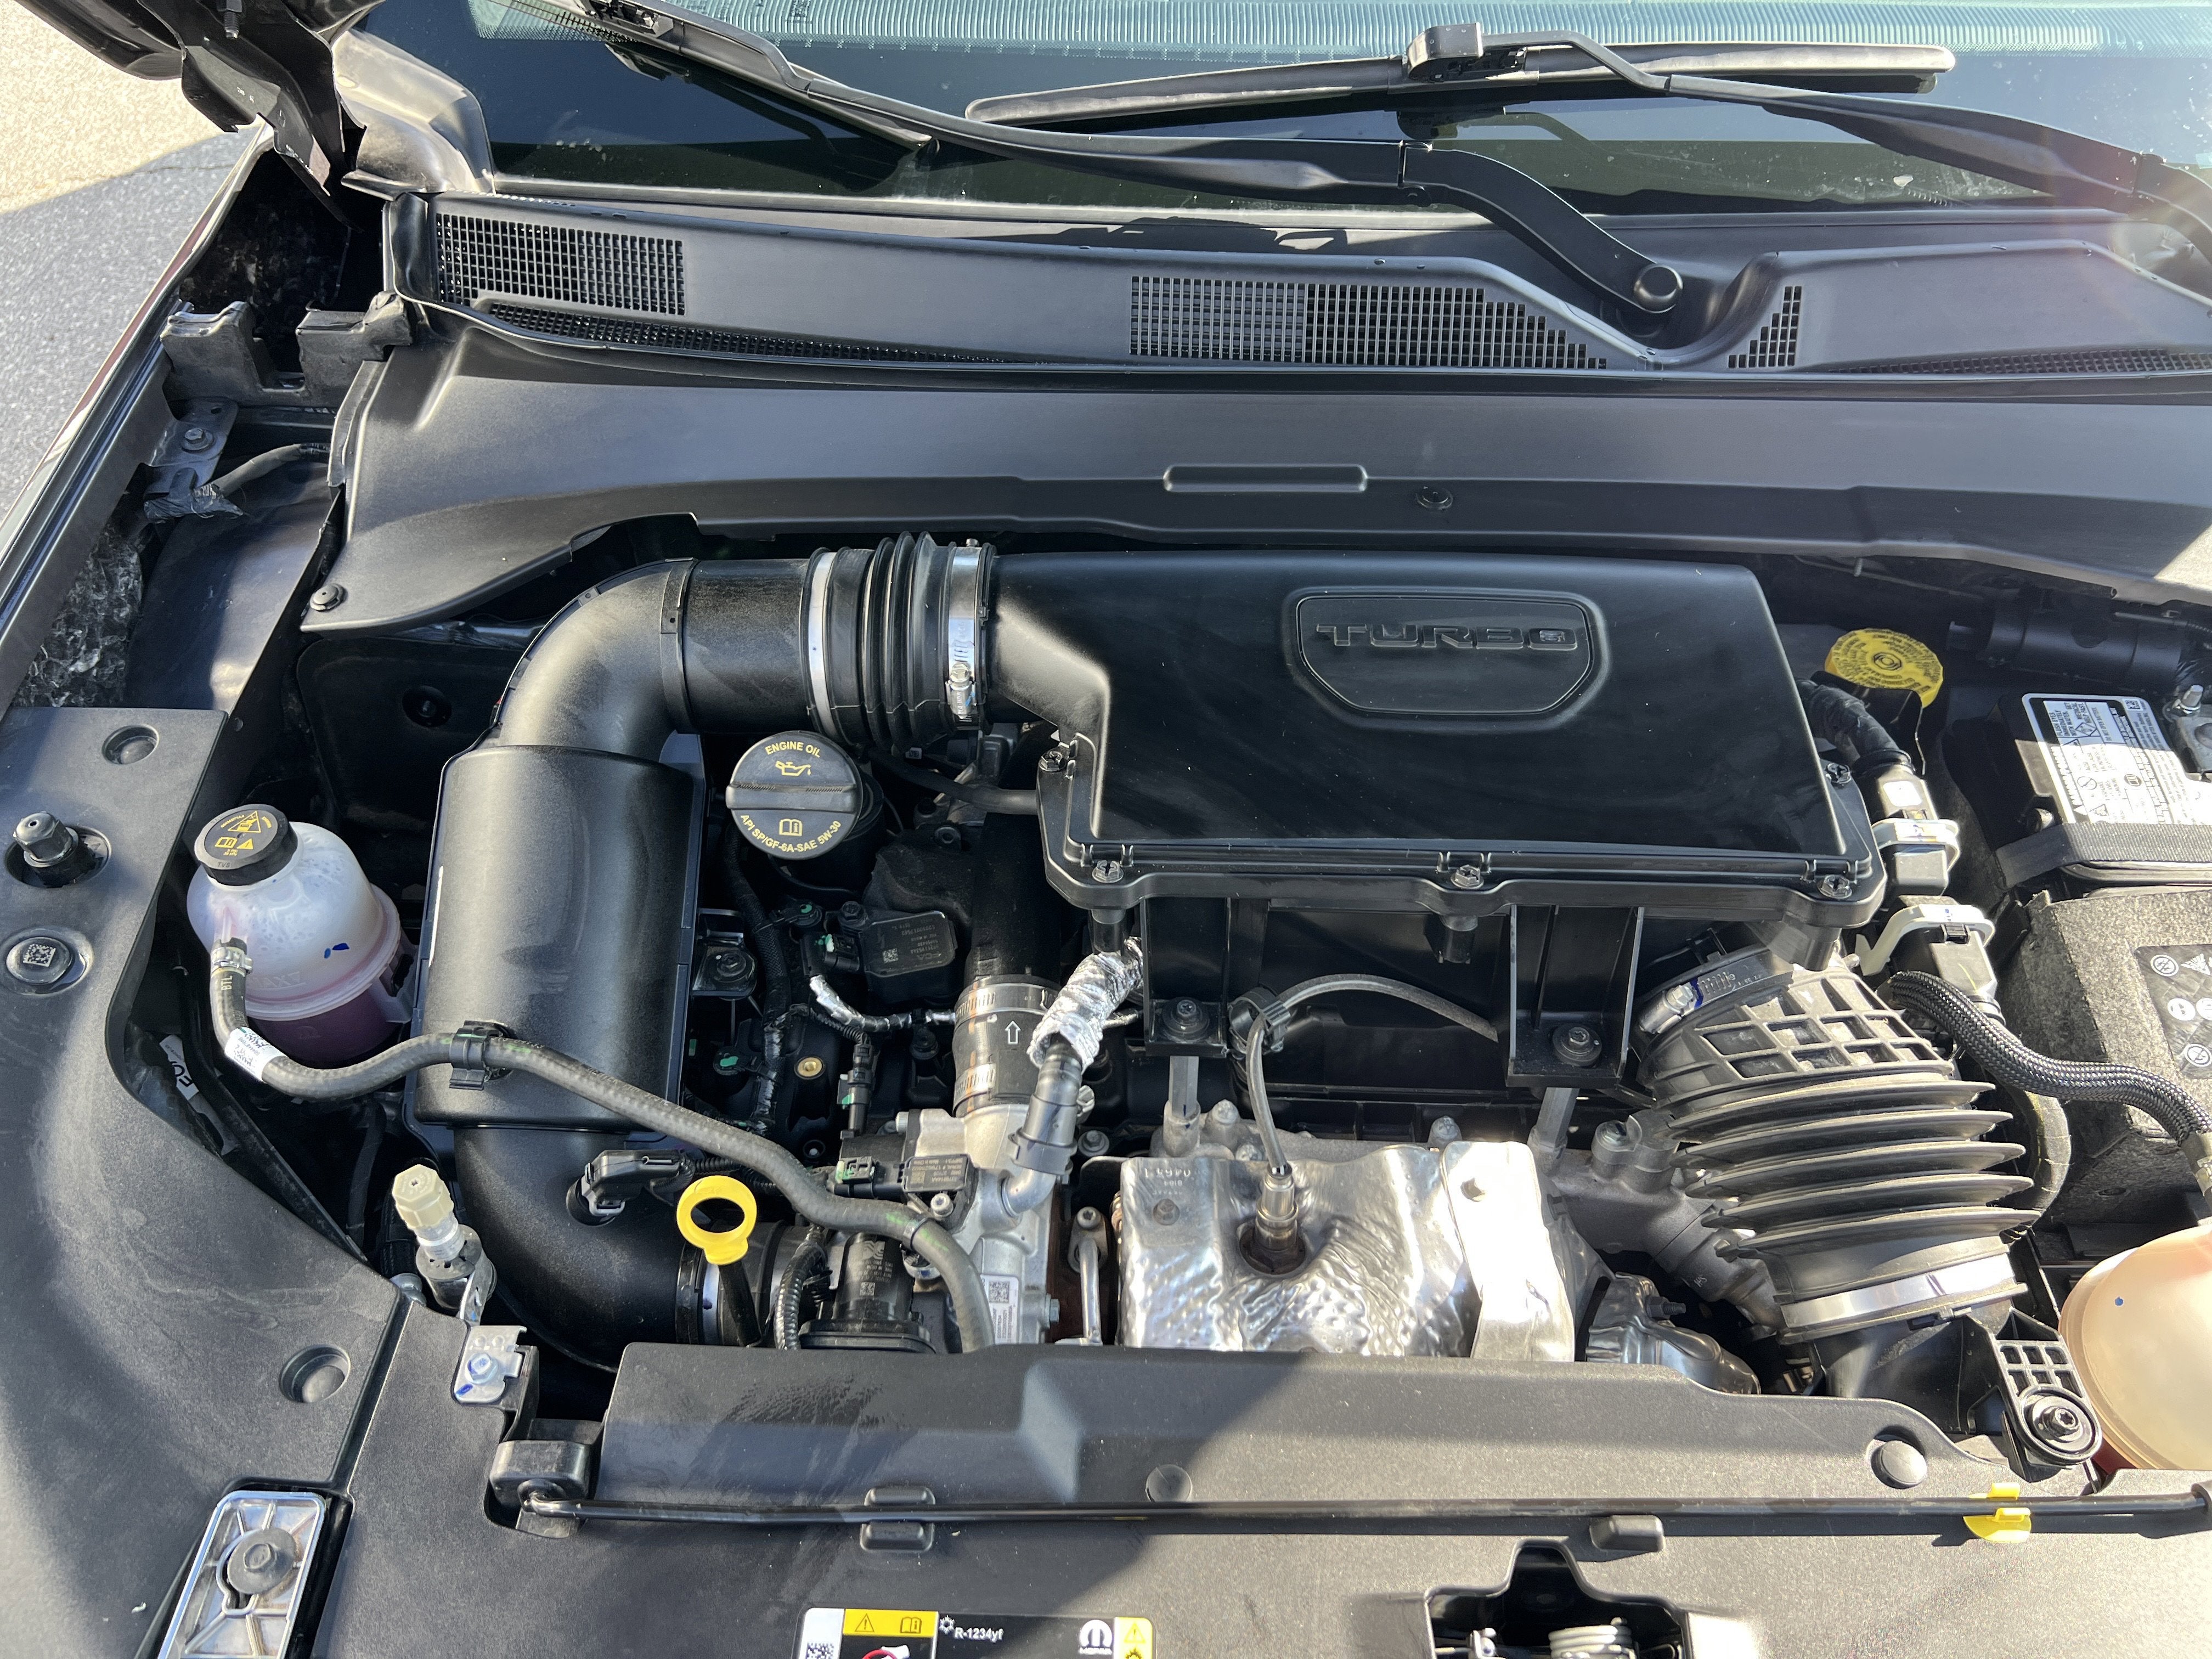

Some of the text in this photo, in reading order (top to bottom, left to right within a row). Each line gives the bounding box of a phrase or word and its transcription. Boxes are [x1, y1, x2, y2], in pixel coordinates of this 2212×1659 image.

[1316, 623, 1578, 651] TURBO
[765, 741, 821, 758] ENGINE OIL
[740, 814, 753, 831] API
[819, 820, 842, 845] 5W-30
[221, 975, 233, 990] BTL
[955, 1627, 1003, 1641] R-1234yf
